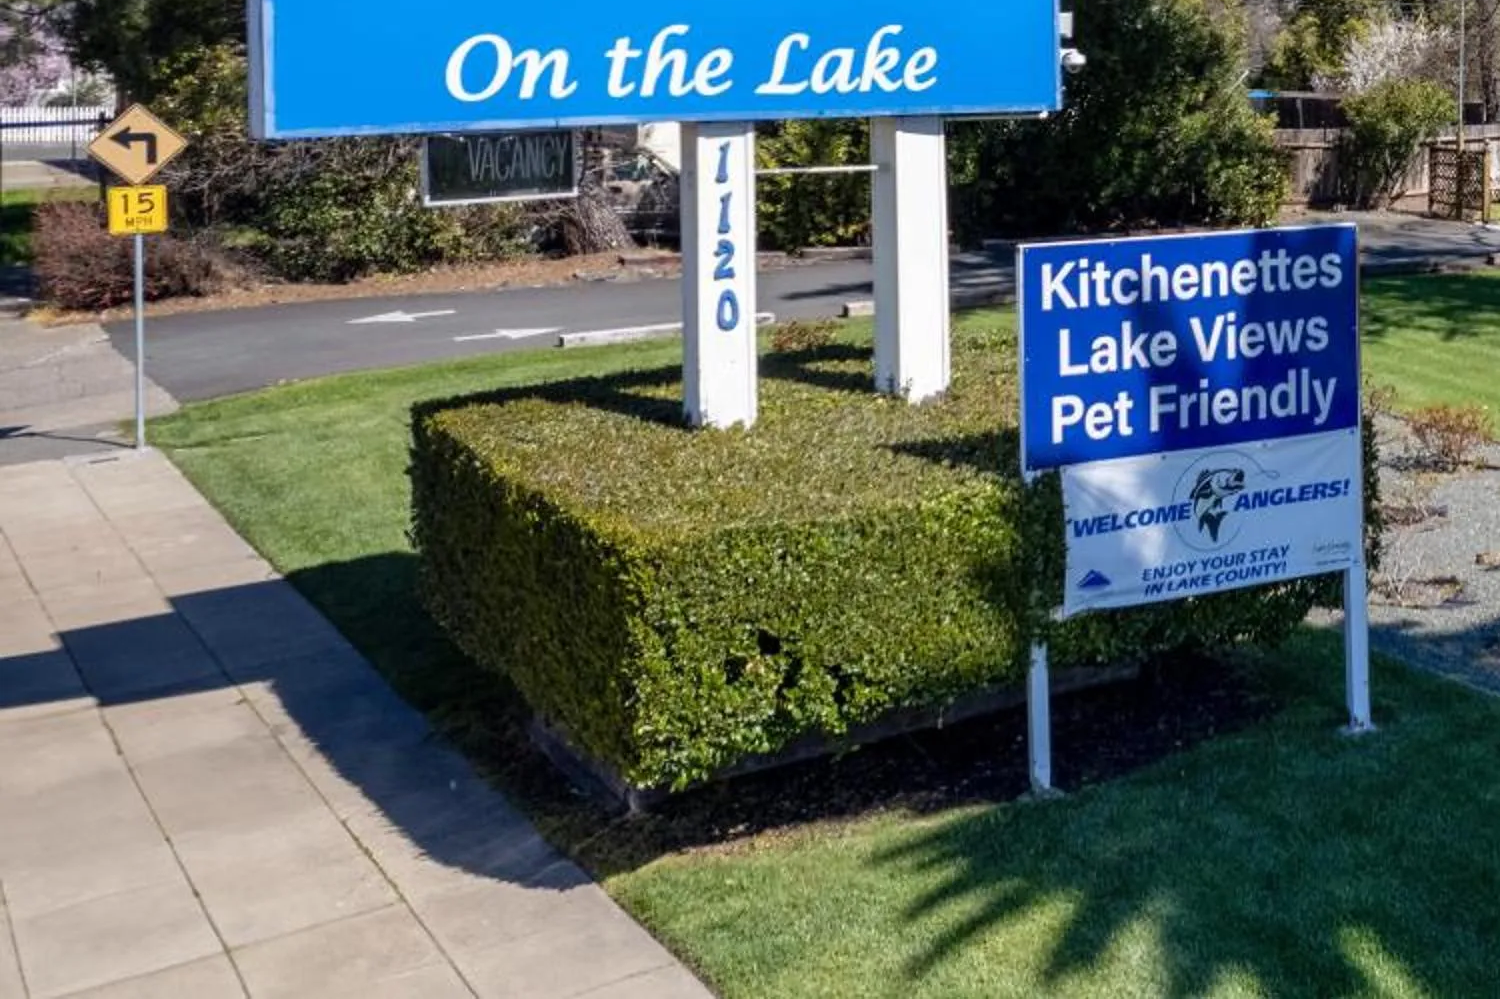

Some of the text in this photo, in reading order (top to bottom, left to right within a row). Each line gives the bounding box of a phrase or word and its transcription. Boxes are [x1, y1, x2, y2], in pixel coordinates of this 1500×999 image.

[445, 24, 938, 102] On the Lake
[467, 135, 568, 182] VACANCY
[122, 192, 155, 215] 15
[713, 140, 740, 332] 1120
[1041, 248, 1343, 311] Kitchenettes
[1059, 311, 1329, 377] Lake Views
[1051, 368, 1337, 444] Pet Friendly
[1073, 479, 1351, 538] WELCOME ANGLERS!
[1141, 560, 1197, 582] ENJOY
[1201, 551, 1246, 572] YOUR
[1250, 544, 1291, 563] STAY
[1145, 561, 1288, 597] IN LAKE COUNTY!
